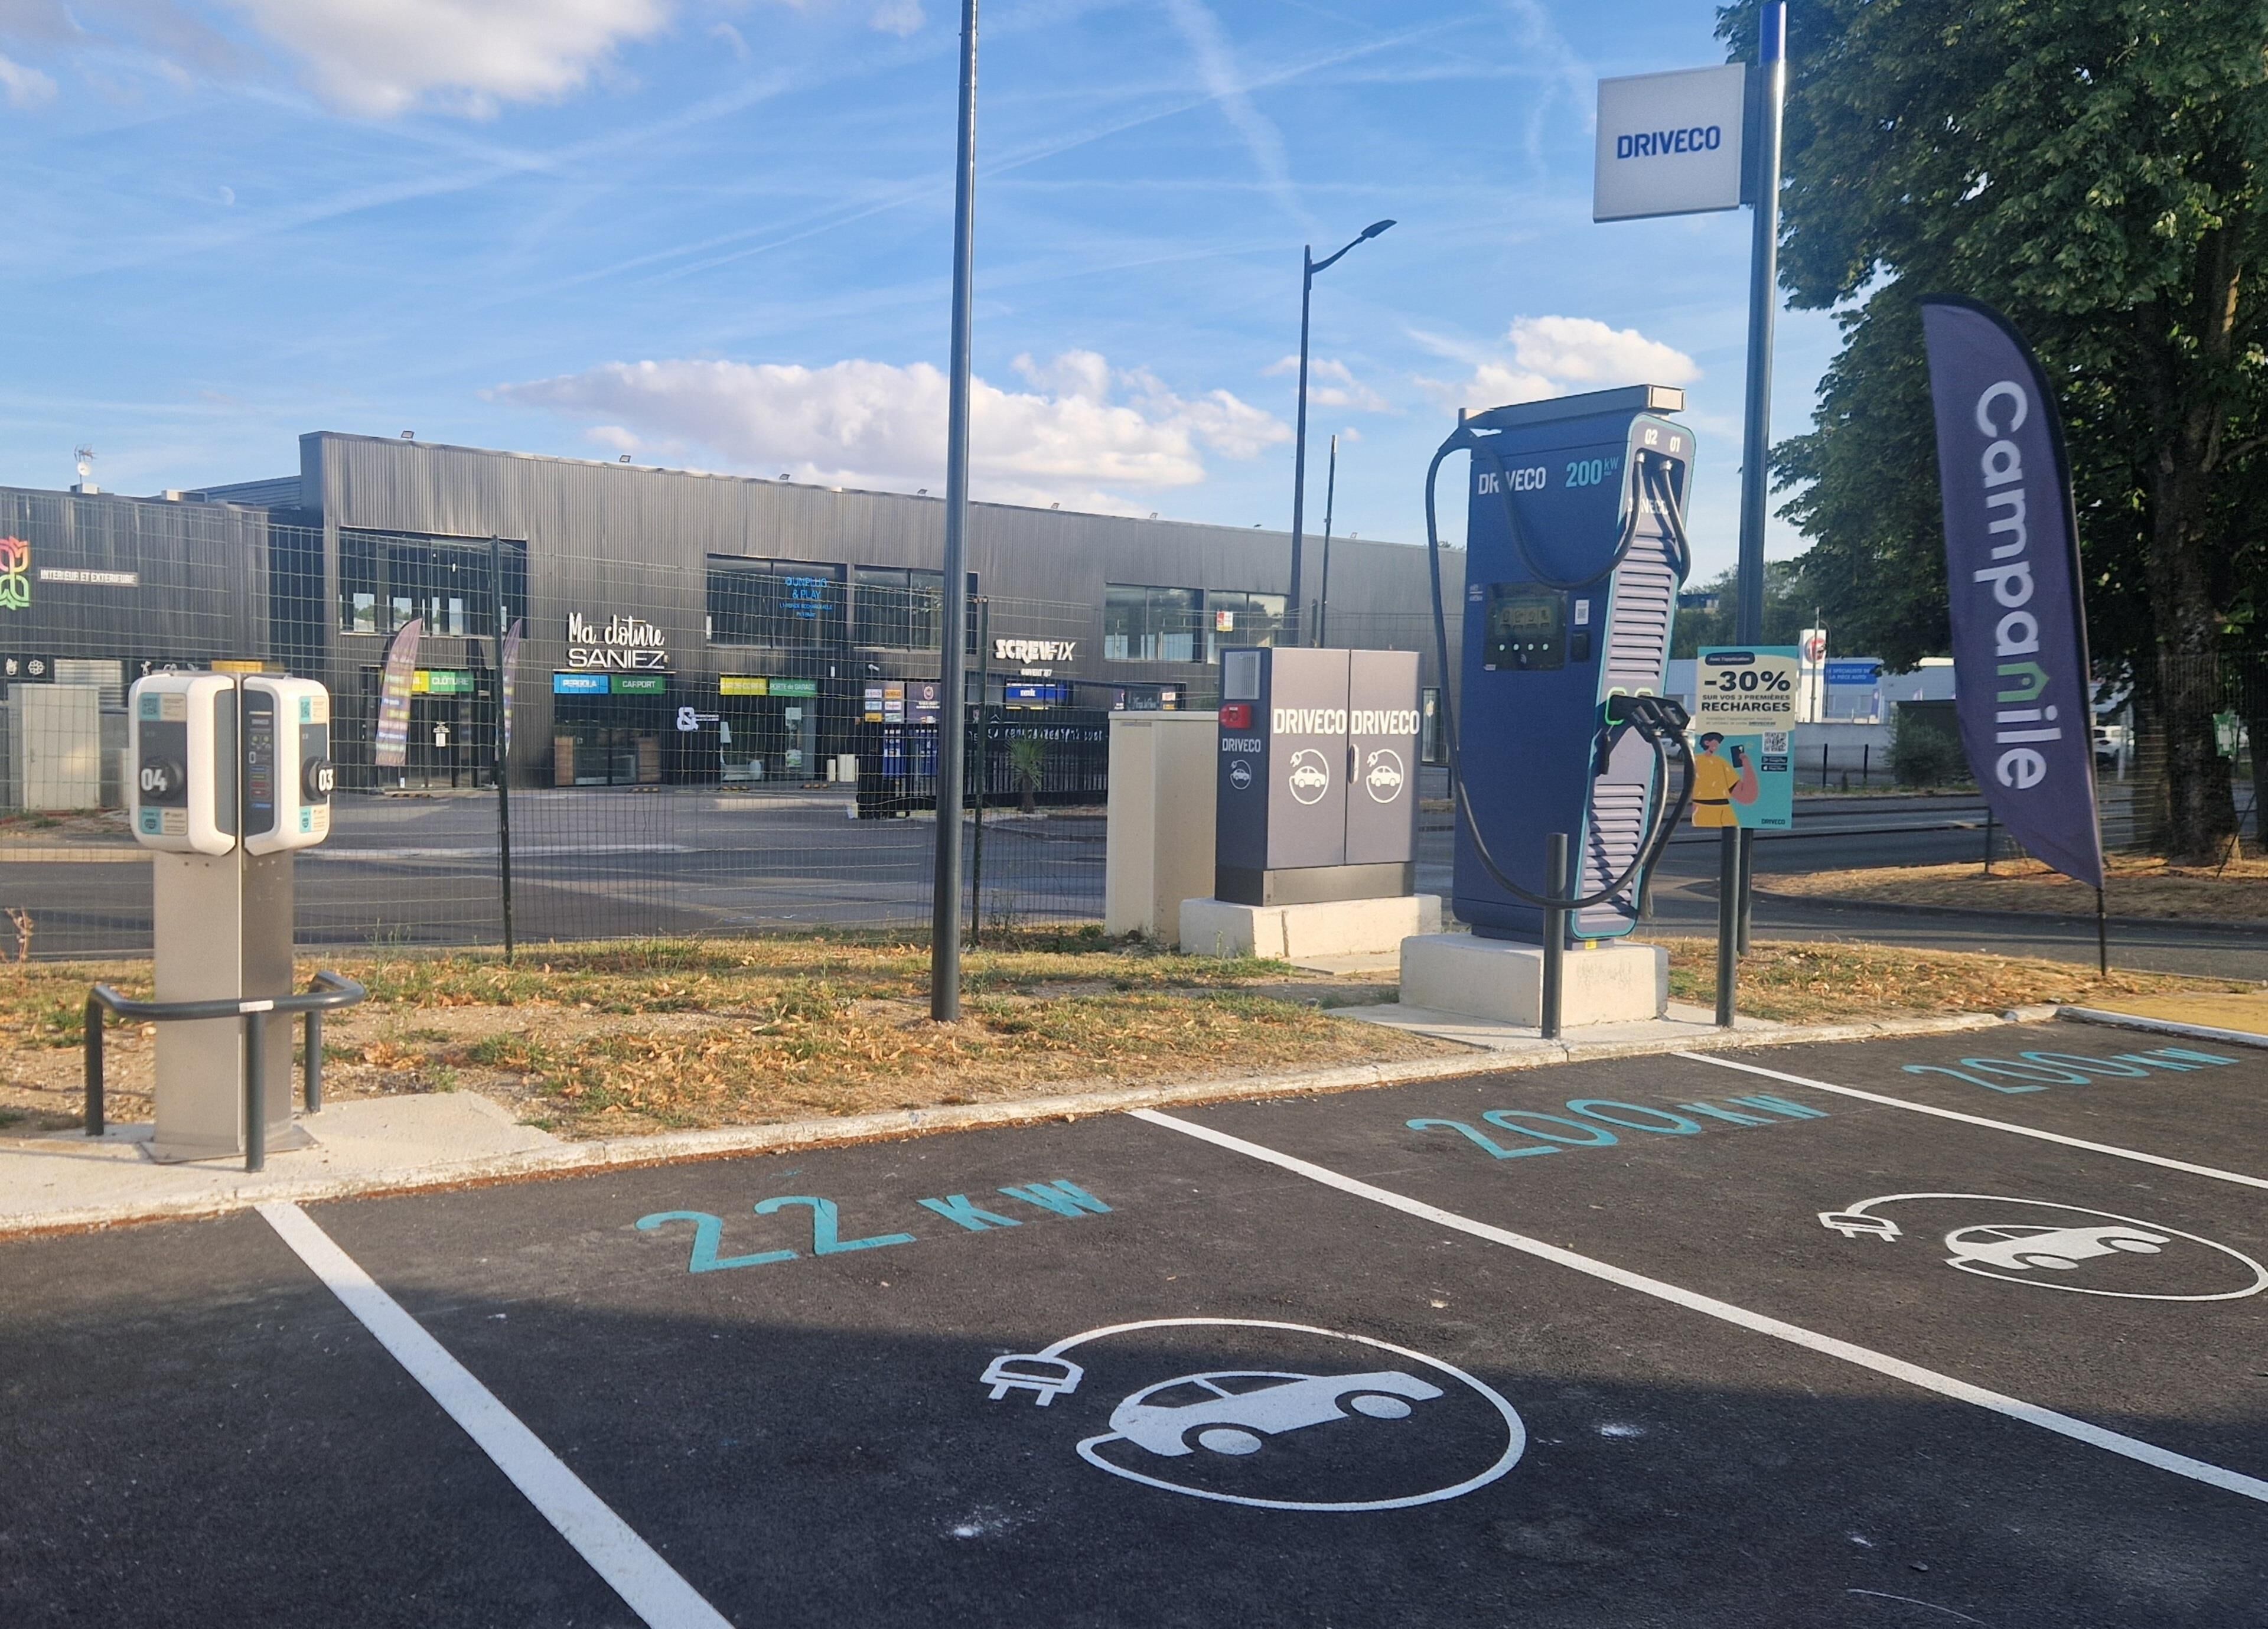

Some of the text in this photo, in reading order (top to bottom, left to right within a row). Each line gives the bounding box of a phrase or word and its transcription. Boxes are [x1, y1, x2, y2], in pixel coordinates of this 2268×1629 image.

[1617, 125, 1721, 159] DRIVECO
[1644, 428, 1658, 445] 02
[1669, 435, 1681, 453] 01
[1478, 467, 1546, 494] DRVECO
[1565, 459, 1602, 488] 200
[80, 572, 90, 582] ET
[1973, 380, 2062, 790] Campanile
[800, 589, 821, 600] PLAY
[568, 612, 597, 644] Ma
[568, 647, 665, 669] SANIEZ
[995, 639, 1076, 664] SCREWFIX
[432, 675, 470, 686] CLÔTURE
[622, 680, 656, 689] CARPORT
[1704, 671, 1791, 692] -30%
[1701, 702, 1791, 712] RECHARGES
[1272, 708, 1347, 734] DRIVECO
[1351, 710, 1420, 735] DRIVECO
[1222, 738, 1261, 753] DRIVECO
[140, 767, 168, 792] 04
[318, 768, 334, 792] 03
[1901, 1051, 2150, 1094] 200
[1405, 1099, 1702, 1160] 200
[636, 1195, 917, 1273] 22
